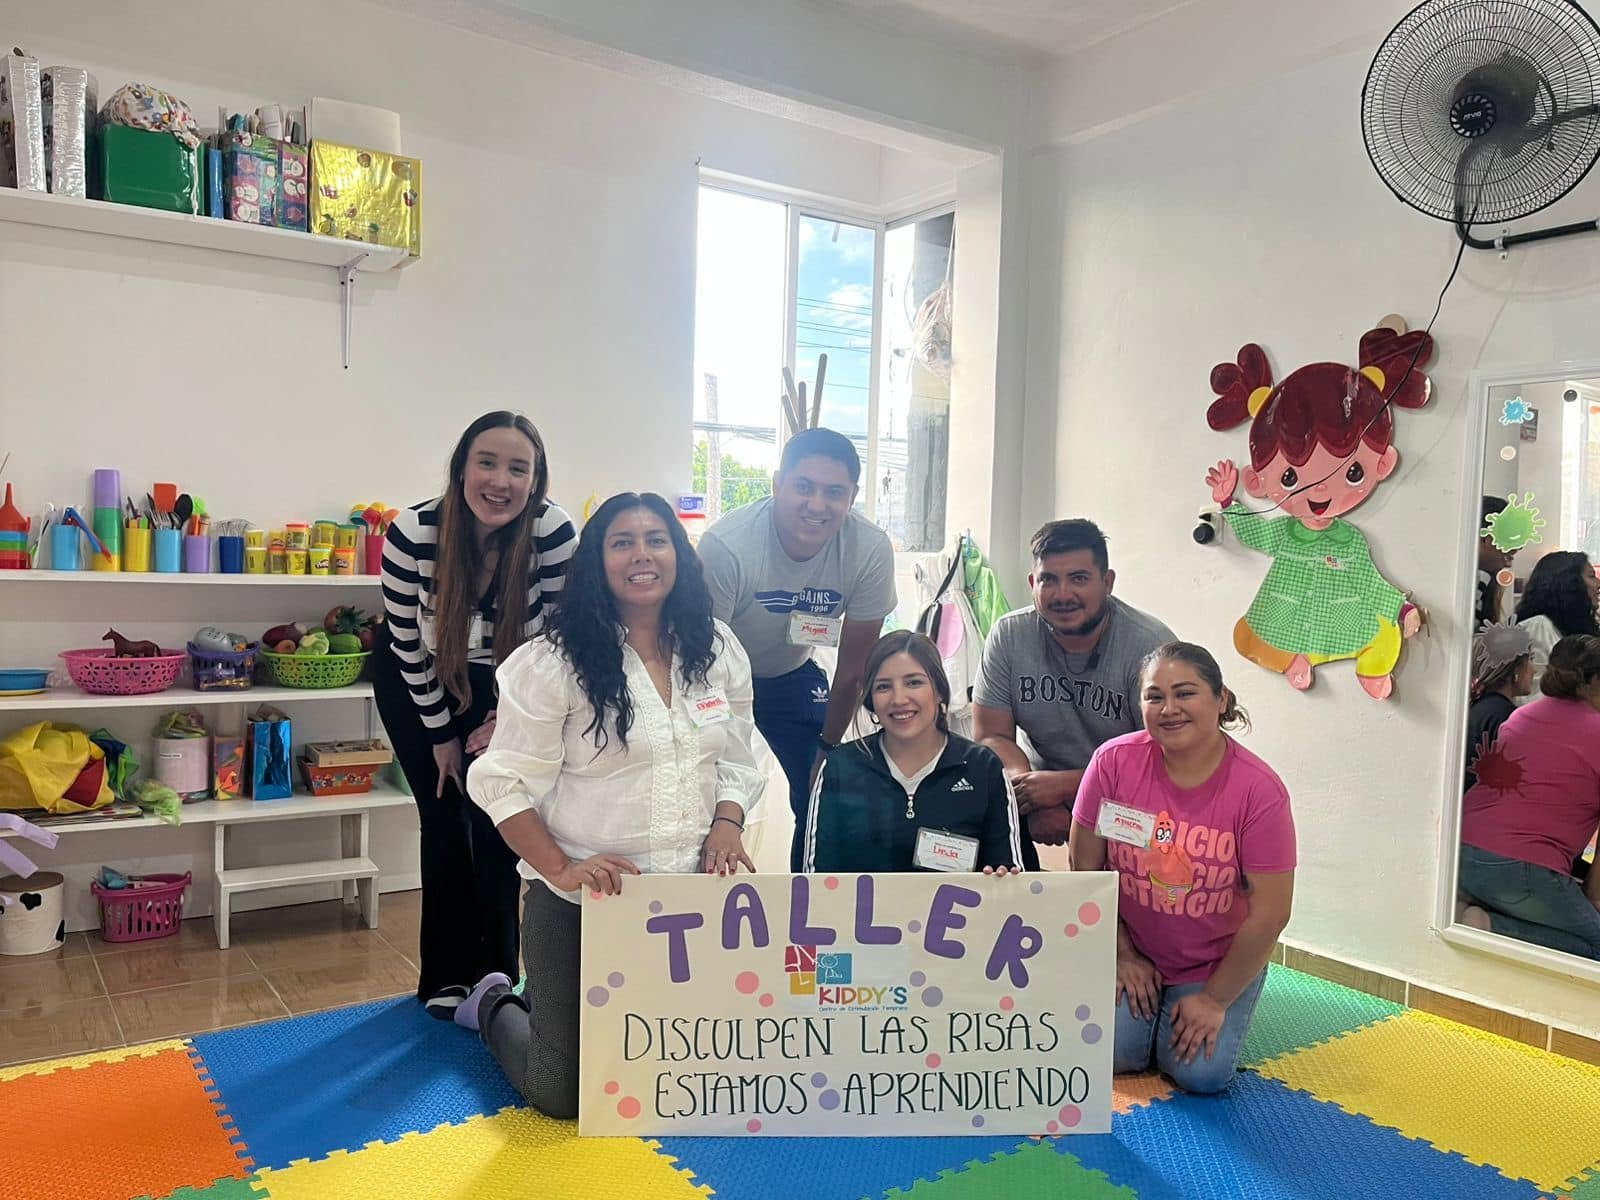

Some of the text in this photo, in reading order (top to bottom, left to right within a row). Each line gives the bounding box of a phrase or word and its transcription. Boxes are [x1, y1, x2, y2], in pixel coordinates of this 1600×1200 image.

[1019, 675, 1125, 721] BOSTON
[1120, 873, 1234, 918] ATRICIO
[646, 874, 1043, 989] TALLER
[819, 986, 908, 1005] KIDDY'S
[624, 1012, 1059, 1062] DISCULPEN LAS RISAS
[655, 1066, 1090, 1119] ESTAMOS APRENDIENDO
